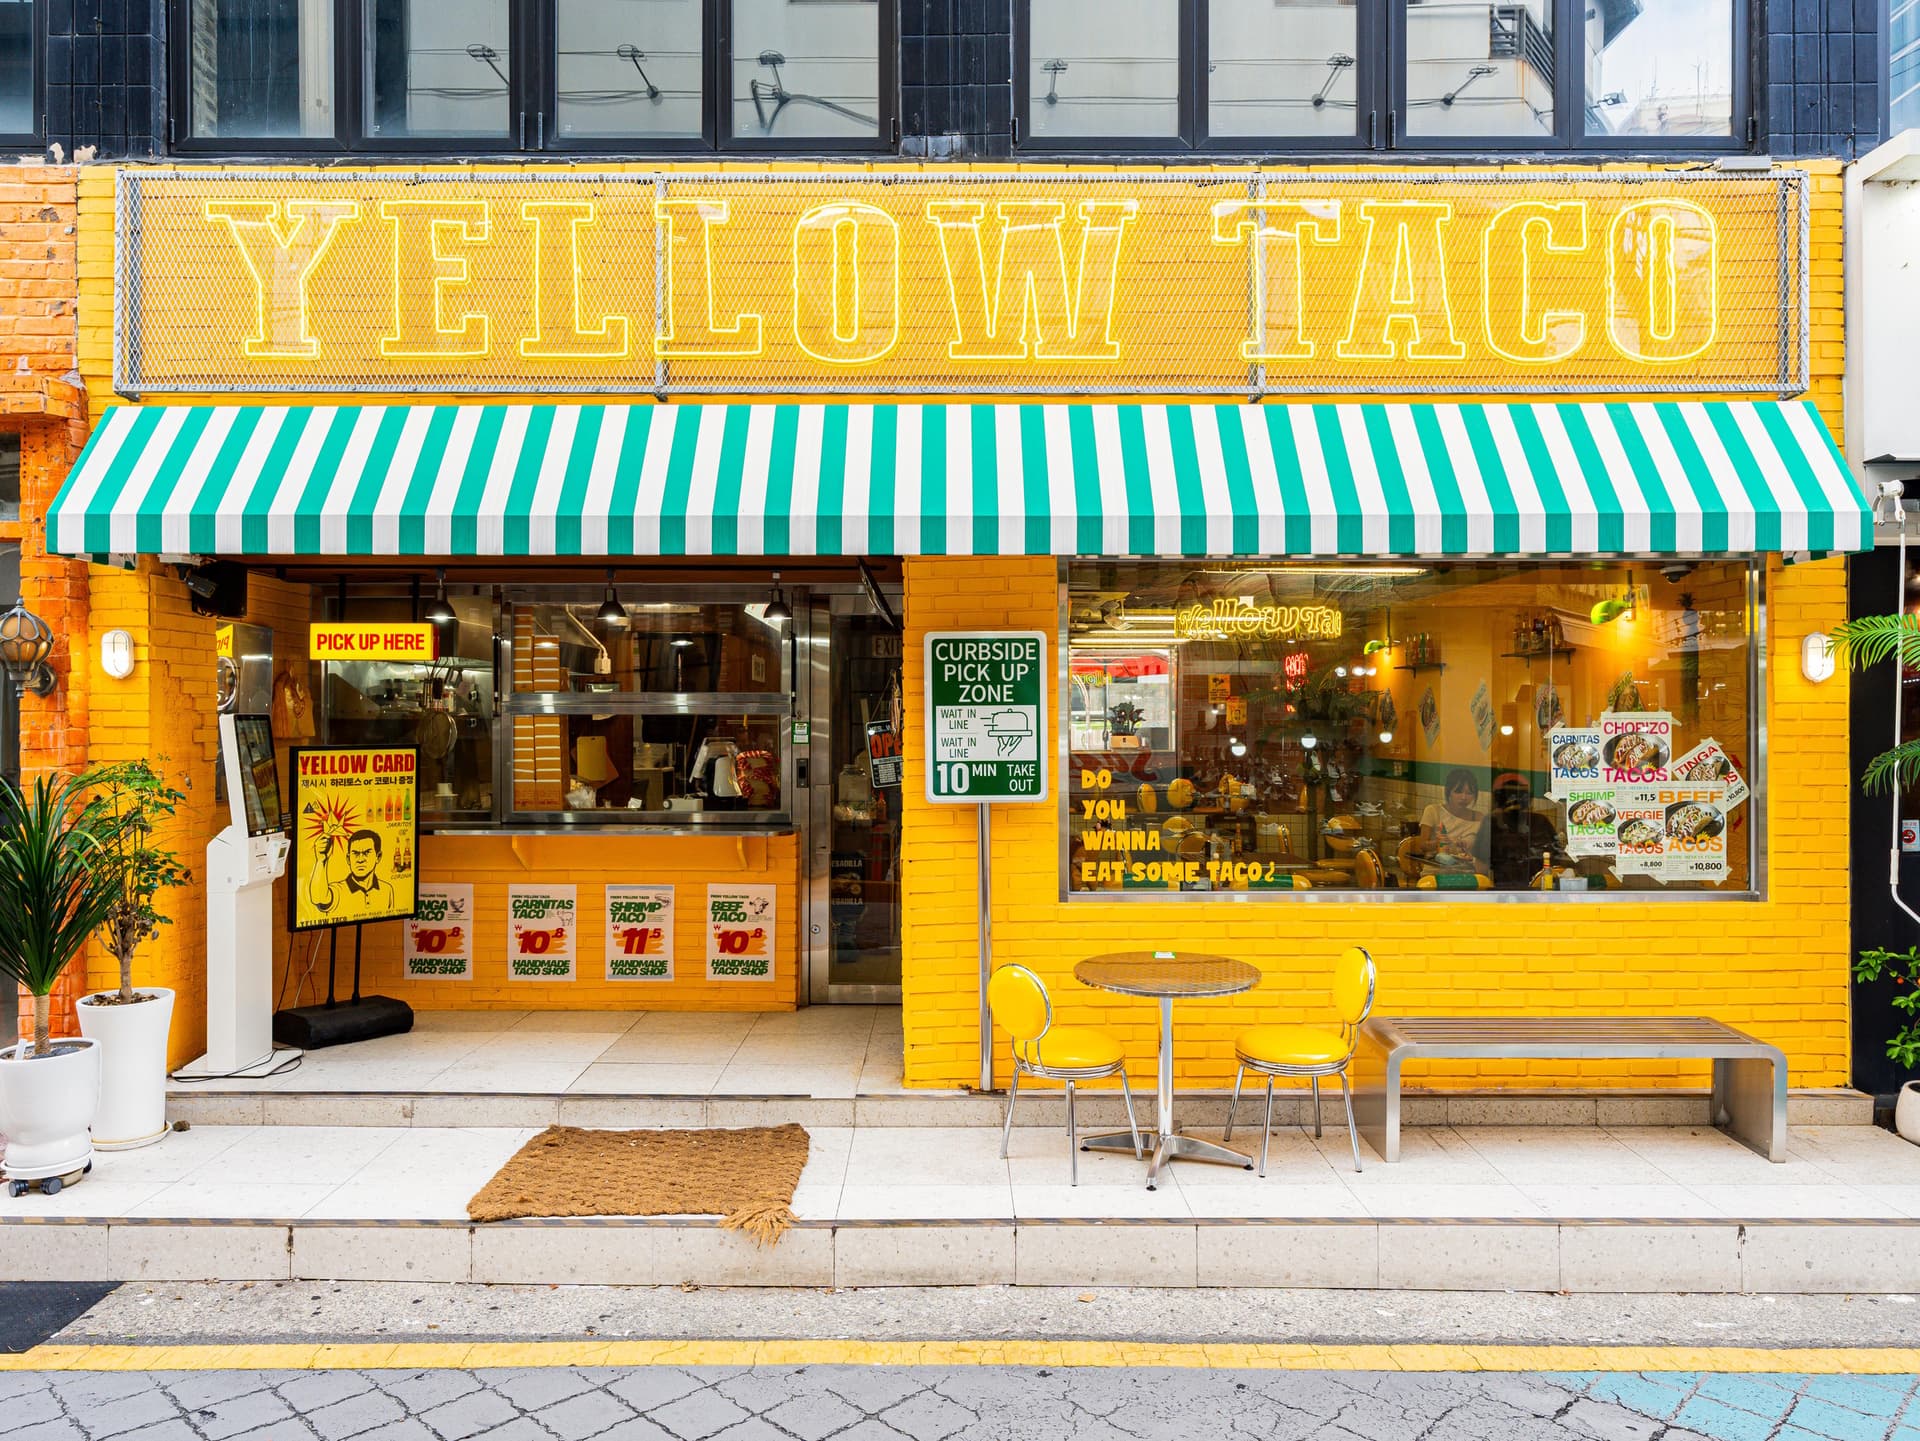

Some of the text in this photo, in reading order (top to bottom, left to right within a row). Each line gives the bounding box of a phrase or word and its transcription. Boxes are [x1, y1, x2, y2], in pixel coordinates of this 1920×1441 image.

[203, 198, 1719, 366] YELLOW TACO
[316, 634, 424, 650] PICK UP HERE
[935, 642, 1037, 661] CURBSIDE
[944, 664, 1029, 682] PICK UP
[959, 684, 1014, 702] ZONE
[941, 709, 976, 719] WAIT IN
[949, 720, 968, 730] LINE
[941, 737, 977, 747] WAIT IN
[1552, 735, 1600, 744] CARNITAS
[870, 732, 902, 759] OPE
[949, 748, 969, 758] LINE
[300, 754, 415, 775] YELLOW CARD
[1674, 744, 1718, 776] TINGA
[937, 763, 1036, 794] 10 MIN TAKE
[1553, 767, 1599, 779] TACOS
[1602, 767, 1668, 783] TACOS
[1081, 769, 1112, 789] DO
[1009, 779, 1034, 791] OUT
[1569, 791, 1615, 801] SHRIMP
[1658, 791, 1724, 803] BEEF
[1082, 800, 1126, 820] YOU
[1617, 811, 1664, 820] VEGGIE
[1569, 823, 1616, 836] TACOS
[1082, 831, 1160, 850] WANNA
[1668, 836, 1723, 853] ACOS
[1618, 843, 1664, 854] TACOS
[1081, 862, 1125, 881] EAT
[1132, 862, 1201, 882] SOME
[417, 900, 448, 911] INGA
[512, 899, 574, 909] CARNITAS
[610, 901, 662, 913] SHRIMP
[711, 901, 744, 911] BEEF
[410, 910, 445, 921] ACO
[512, 909, 545, 919] TACO
[610, 912, 646, 923] TACO
[712, 911, 747, 922] TACO
[409, 959, 467, 967] HANDMADE
[512, 960, 571, 968] HANDMADE
[610, 960, 668, 968] HANDMADE
[711, 959, 769, 967] HANDMADE
[410, 966, 466, 975] TACO SHOP
[514, 967, 570, 976] TACO SHOP
[612, 967, 667, 976] TACO SHOP
[712, 967, 768, 976] TACO SHOP
